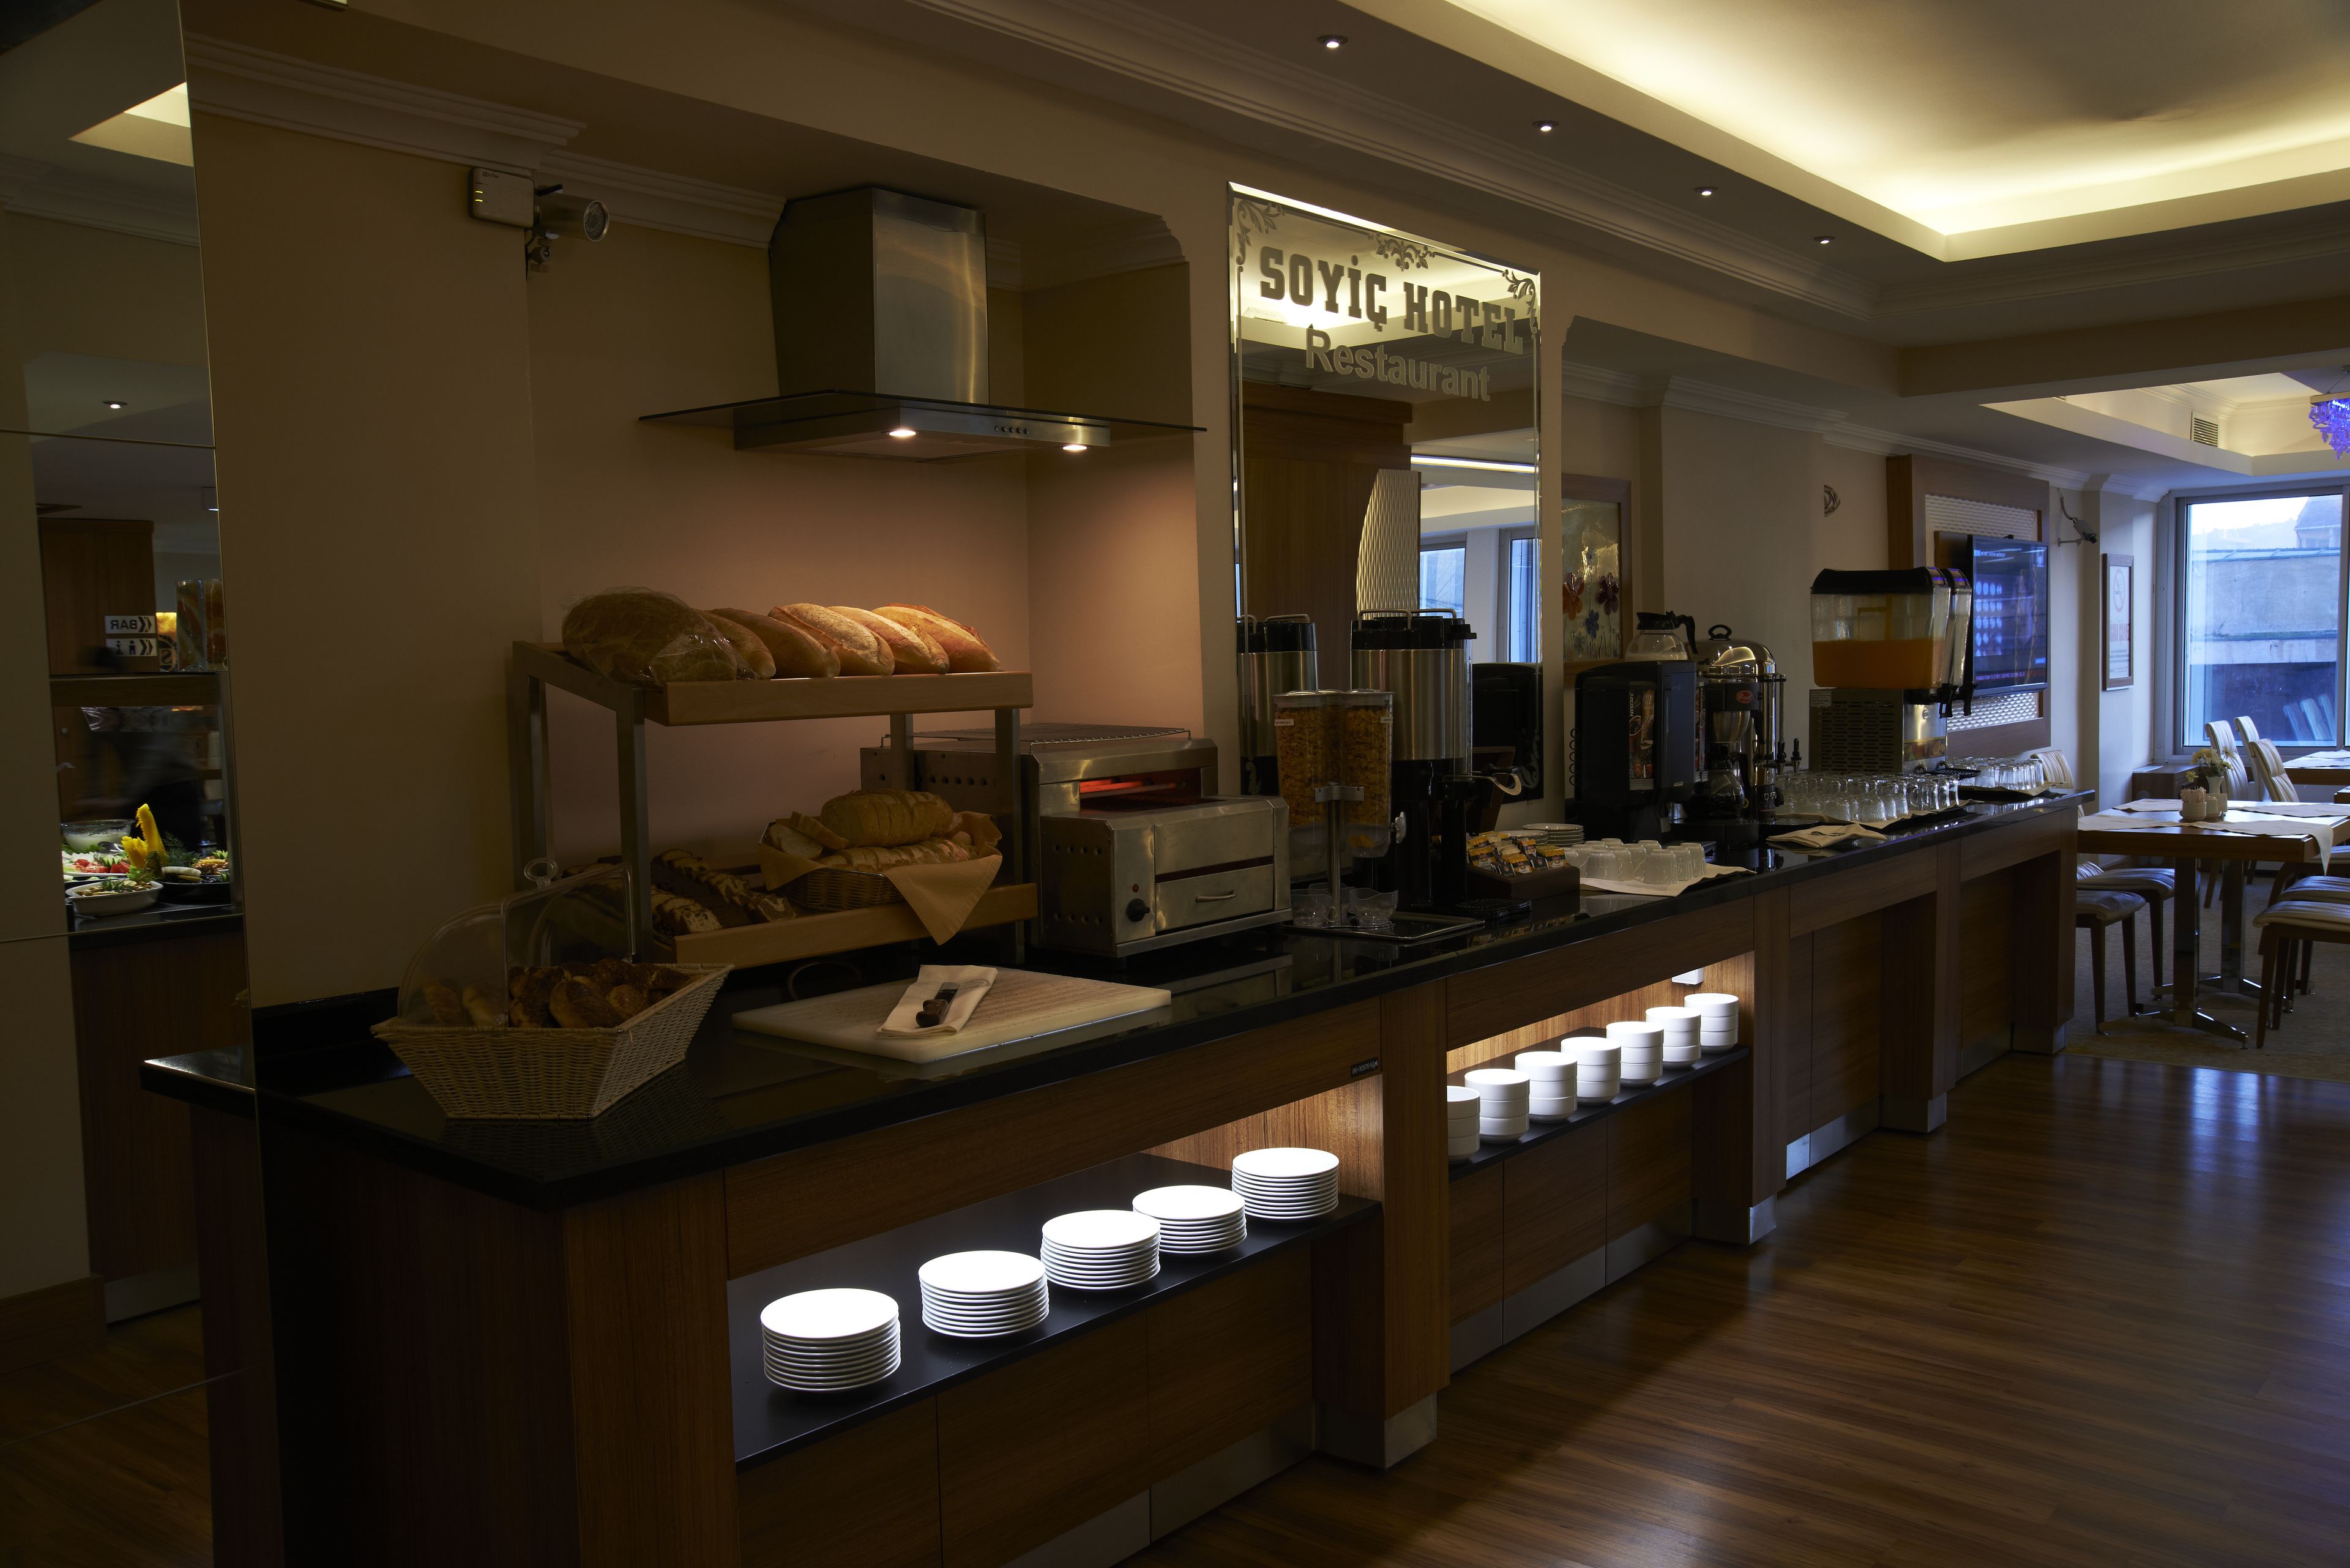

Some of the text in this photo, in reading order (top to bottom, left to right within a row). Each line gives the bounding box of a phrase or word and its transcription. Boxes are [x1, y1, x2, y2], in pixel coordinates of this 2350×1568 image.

[1259, 245, 1523, 355] SOYİÇ HOTEL
[1305, 323, 1491, 402] Restaurant
